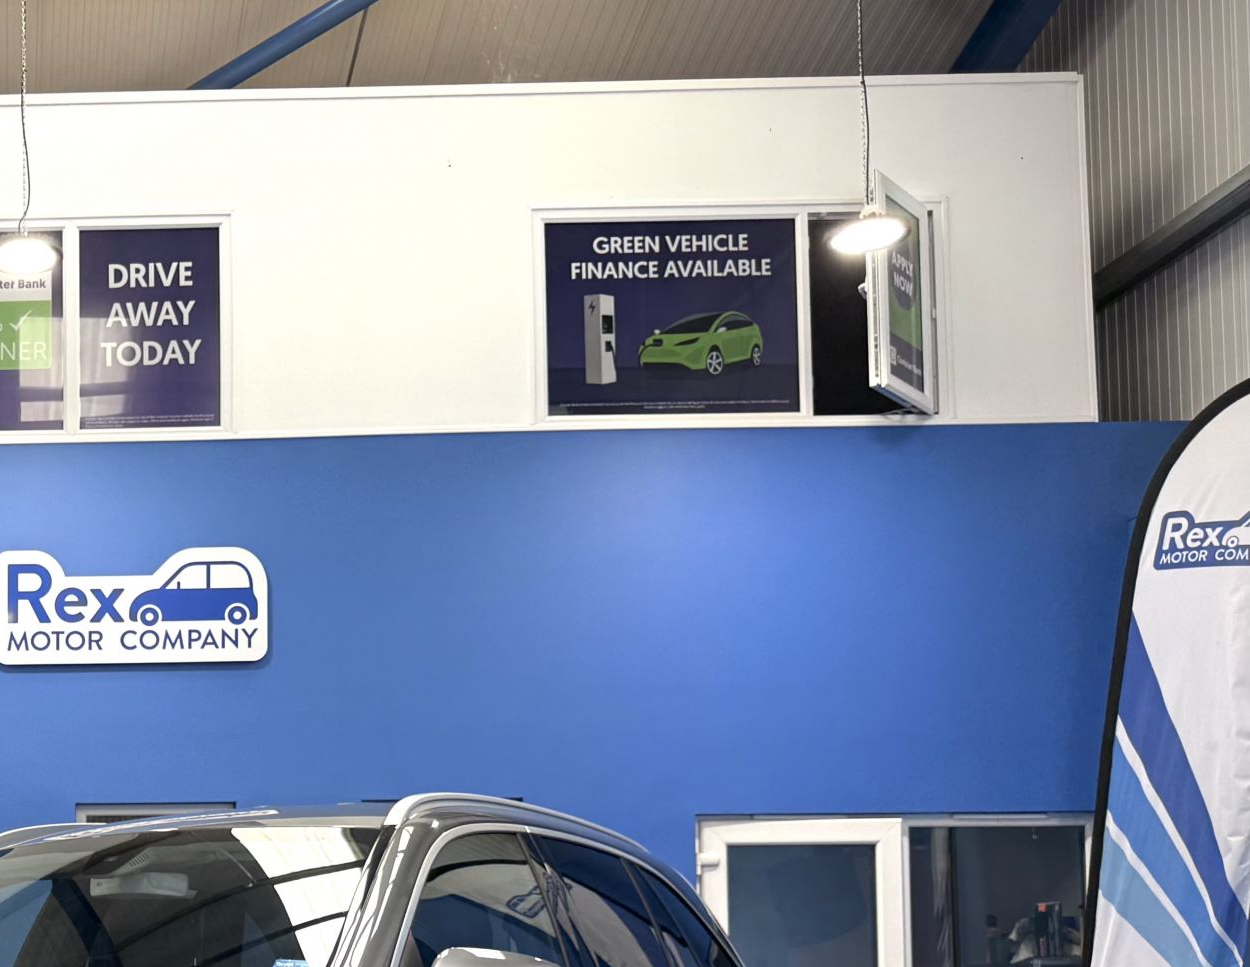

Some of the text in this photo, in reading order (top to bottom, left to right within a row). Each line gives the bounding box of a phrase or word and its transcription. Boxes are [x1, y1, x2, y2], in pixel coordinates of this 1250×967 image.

[592, 233, 749, 254] GREEN VEHICLE
[108, 261, 193, 289] DRIVE
[570, 258, 772, 280] FINANCE AVAILABLE
[892, 251, 914, 277] APPLY
[18, 278, 47, 289] Bank
[893, 272, 914, 297] NOW
[105, 300, 196, 328] AWAY
[100, 338, 202, 367] TODAY
[1161, 517, 1224, 550] Rex
[1159, 550, 1208, 565] MOTOR
[7, 563, 125, 624] Rex
[7, 628, 258, 652] MOTOR COMPANY
